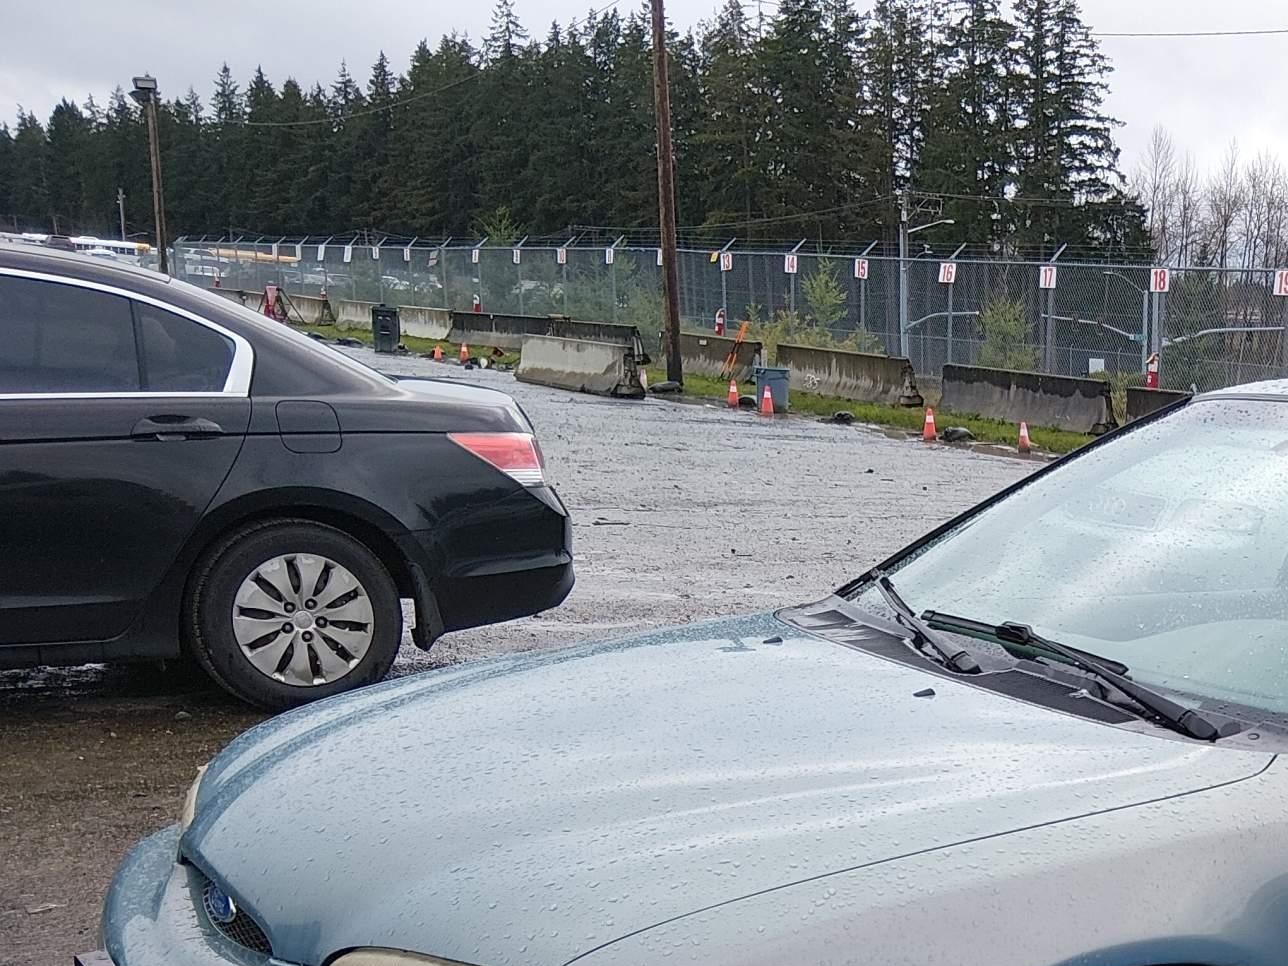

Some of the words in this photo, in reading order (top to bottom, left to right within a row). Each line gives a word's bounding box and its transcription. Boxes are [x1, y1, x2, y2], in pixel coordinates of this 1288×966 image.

[722, 254, 731, 270] 13
[787, 256, 796, 272] 14
[856, 259, 866, 277] 15
[942, 264, 953, 281] 16
[1043, 267, 1053, 287] 17
[1153, 269, 1166, 291] 18
